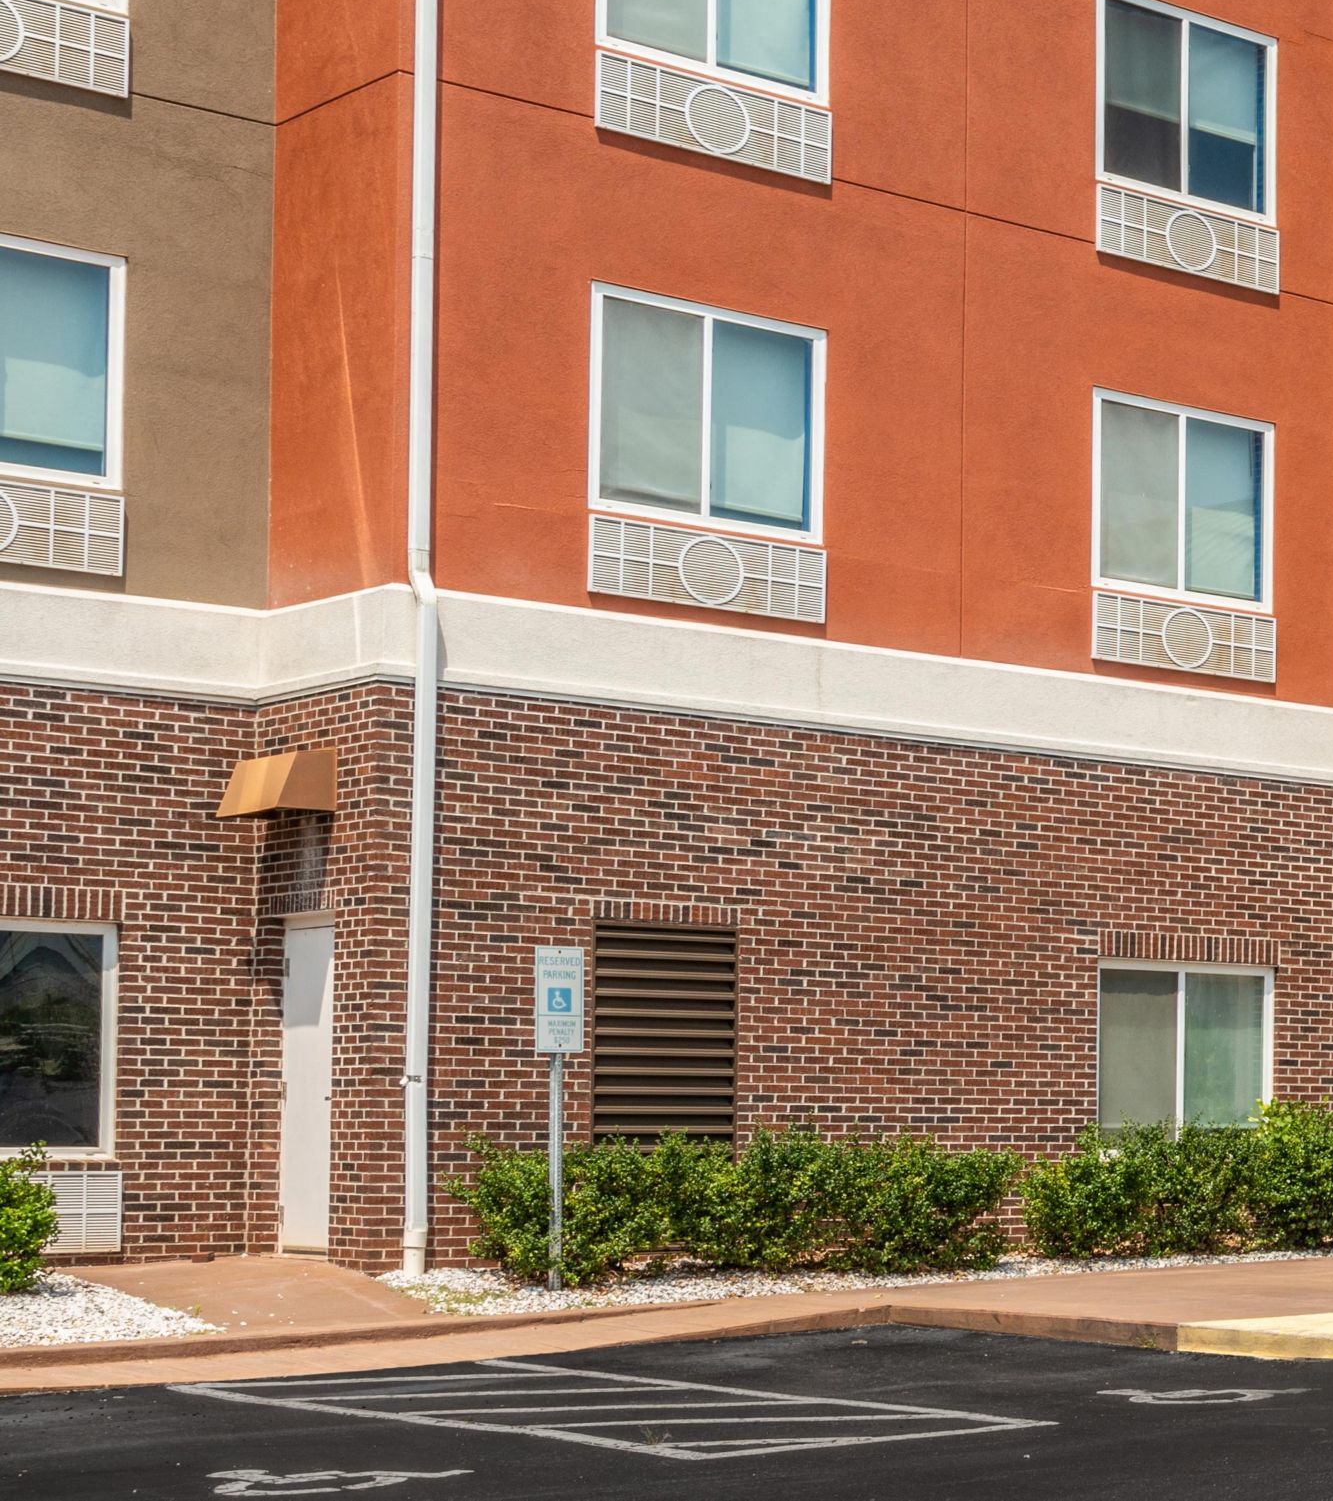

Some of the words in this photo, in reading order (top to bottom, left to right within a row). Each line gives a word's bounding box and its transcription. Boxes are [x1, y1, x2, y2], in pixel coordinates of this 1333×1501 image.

[539, 956, 581, 967] RESERVED
[543, 969, 577, 980] PARKING
[547, 1020, 576, 1028] MAXIMUM
[548, 1028, 575, 1036] PENALTY
